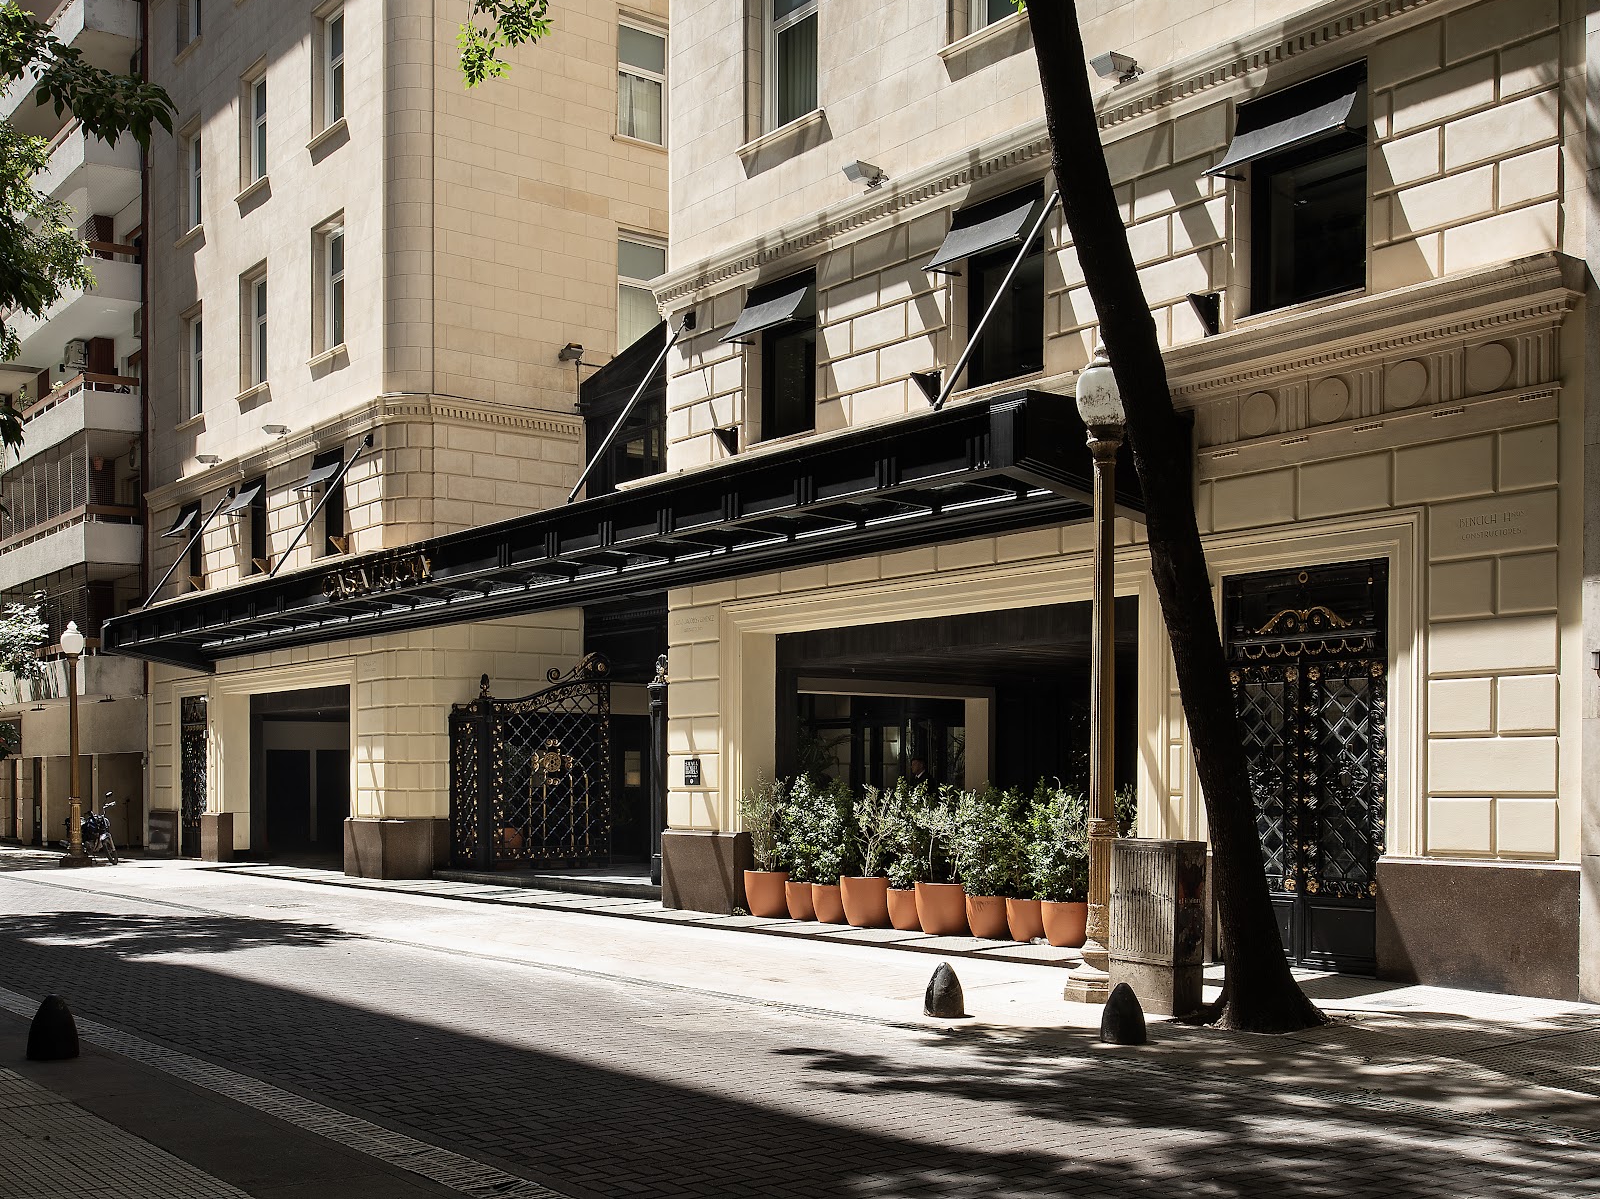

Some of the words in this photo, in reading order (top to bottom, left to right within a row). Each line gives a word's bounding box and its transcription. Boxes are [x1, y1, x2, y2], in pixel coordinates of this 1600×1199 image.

[1459, 513, 1498, 528] BENCICH
[1461, 527, 1522, 541] CONSTRUCTORES
[322, 568, 370, 598] CASA
